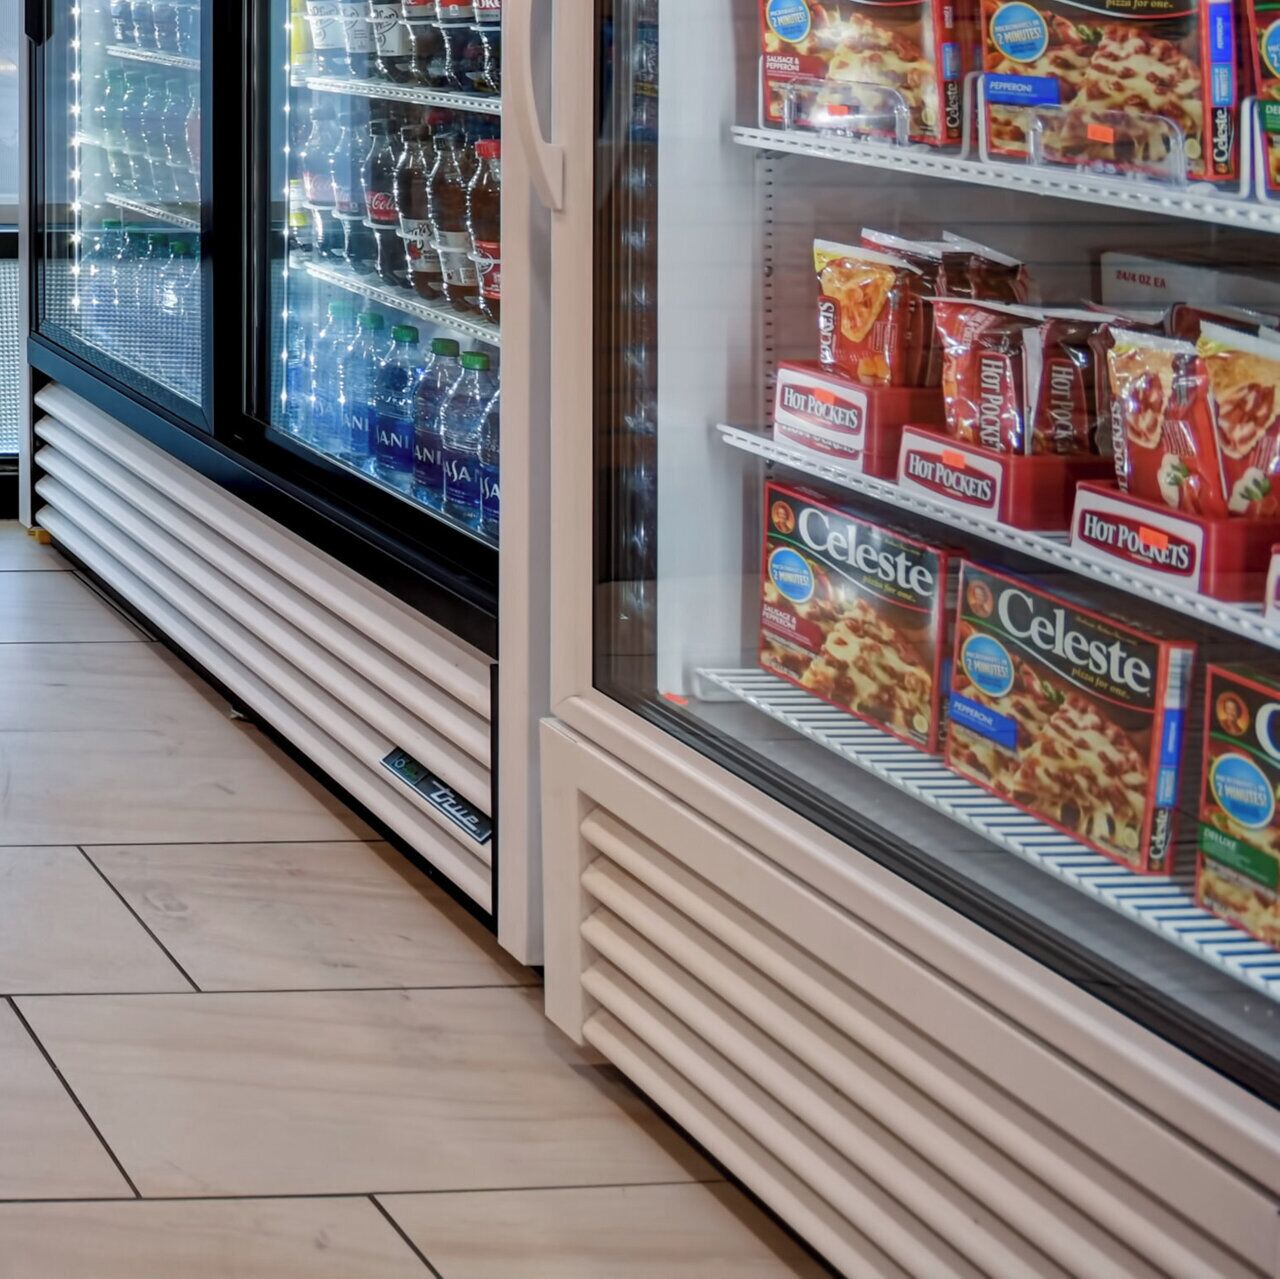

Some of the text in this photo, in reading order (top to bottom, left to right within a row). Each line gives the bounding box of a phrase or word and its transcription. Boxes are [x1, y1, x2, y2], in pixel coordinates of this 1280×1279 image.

[772, 17, 779, 27] 2
[996, 28, 1043, 46] 2 MINUTES!
[766, 55, 794, 65] SAUSAGE
[766, 62, 800, 72] PEPPERONI
[989, 80, 1032, 93] PEPPERONI
[946, 82, 960, 128] Celeste
[1213, 109, 1229, 163] Celeste
[1153, 278, 1167, 289] EA
[981, 358, 1004, 394] HOT
[1051, 364, 1074, 399] HOT
[784, 387, 859, 431] HOT POCKETS
[909, 453, 993, 502] HOT POCKETS
[1083, 511, 1115, 544] HOT
[798, 507, 934, 597] Celeste
[773, 571, 779, 582] 2
[998, 589, 1152, 694] Celeste
[966, 657, 1010, 680] 2 MINUTES!
[1071, 666, 1095, 685] pizza
[1094, 675, 1109, 691] for
[430, 780, 480, 830] true
[1216, 781, 1267, 807] 2 MINUTES!
[1150, 809, 1169, 859] Celeste
